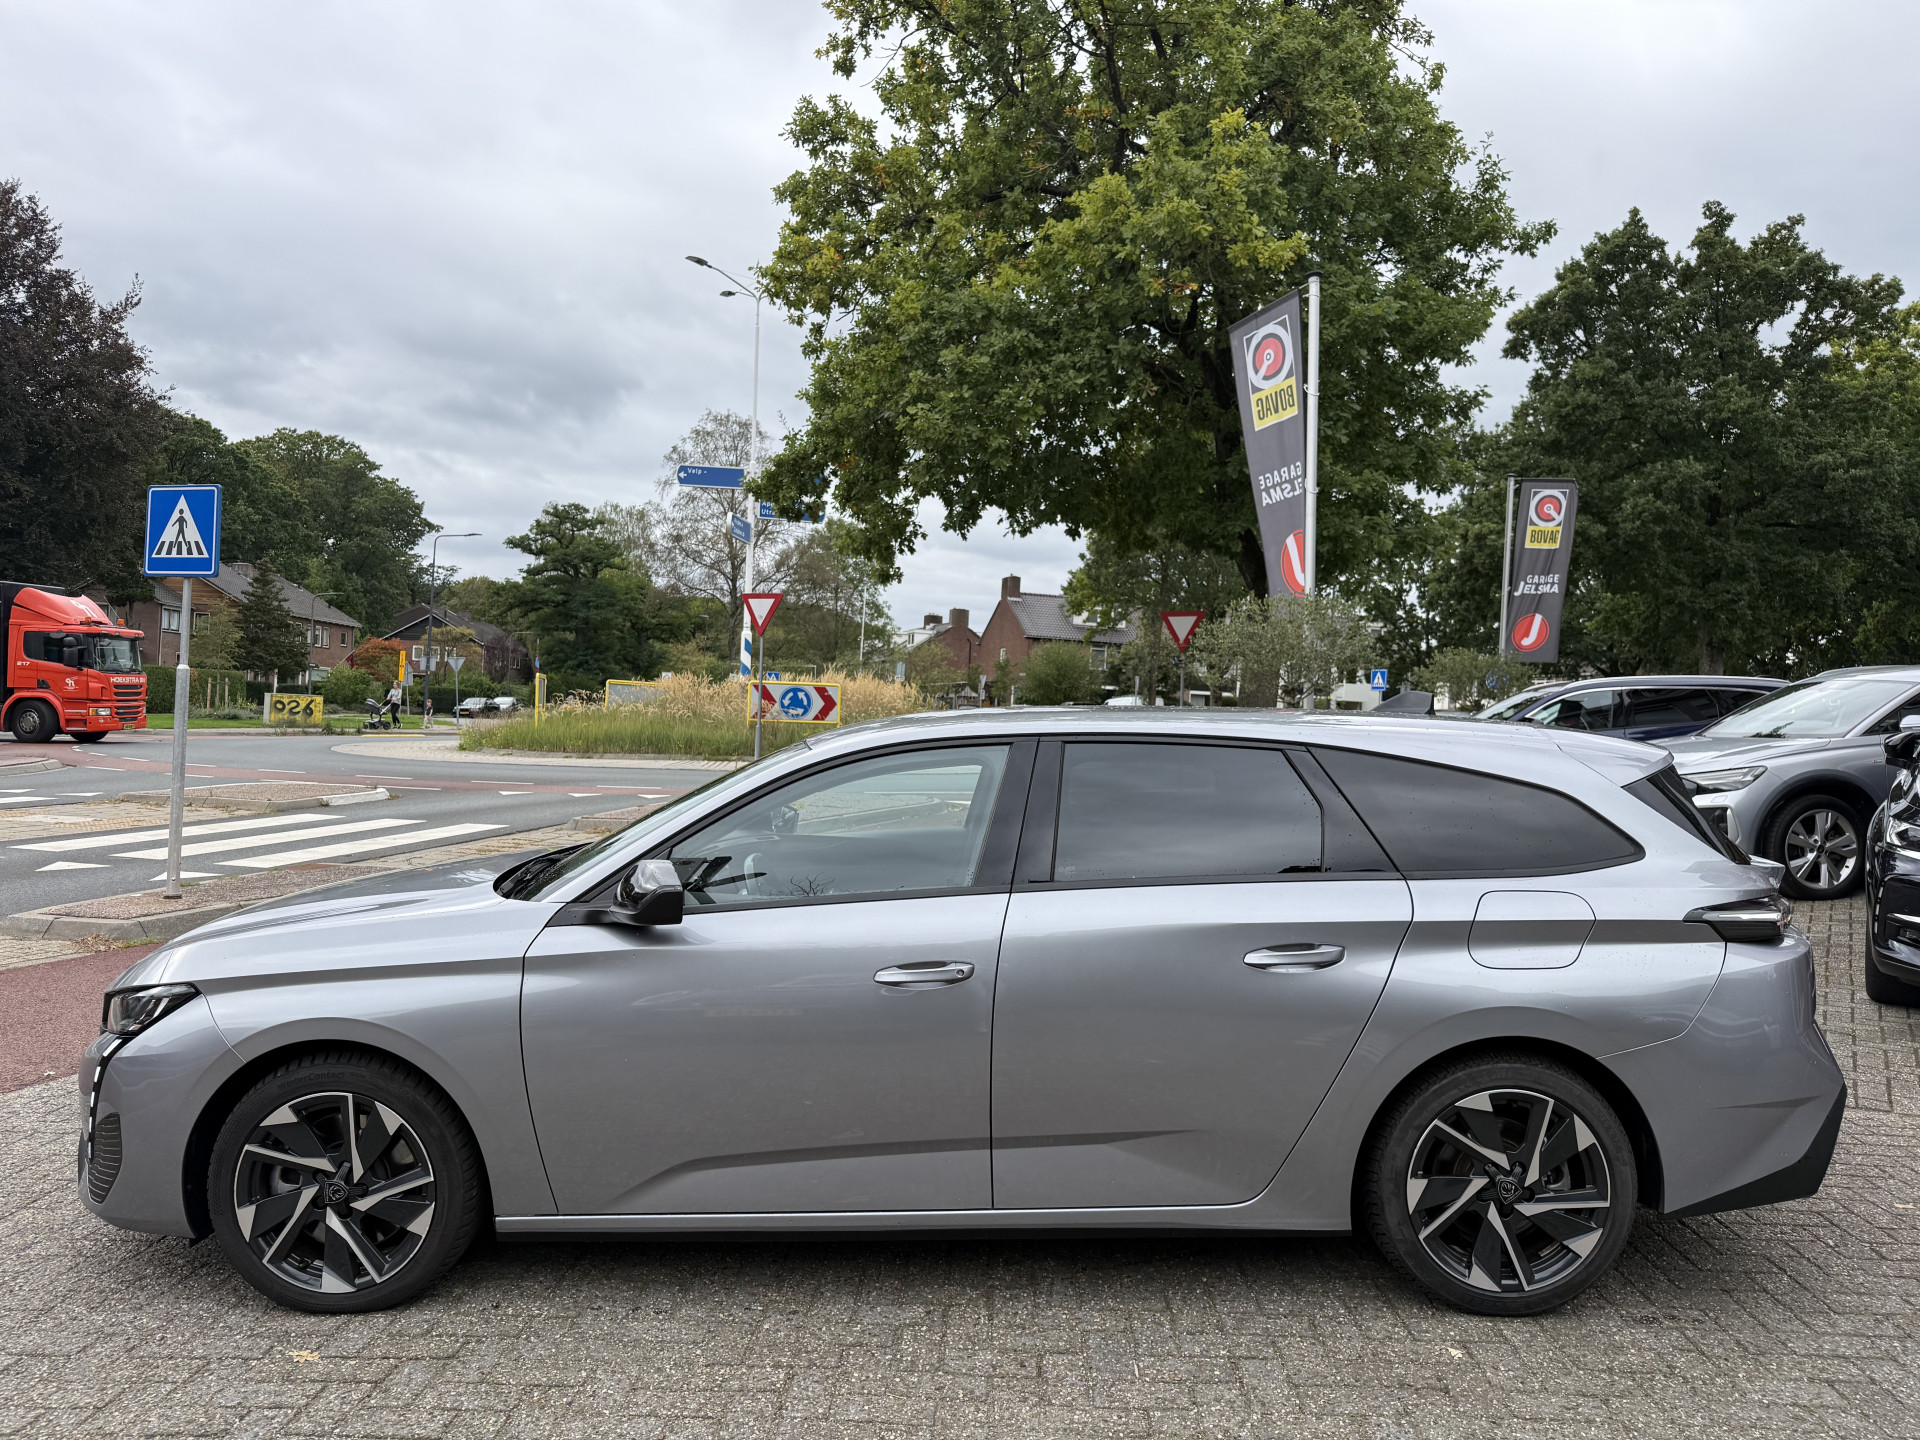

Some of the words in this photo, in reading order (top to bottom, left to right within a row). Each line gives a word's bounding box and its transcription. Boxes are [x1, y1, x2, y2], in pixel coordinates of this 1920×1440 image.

[687, 467, 702, 475] Velp
[1530, 529, 1560, 544] BOVAG
[274, 700, 314, 717] 026
